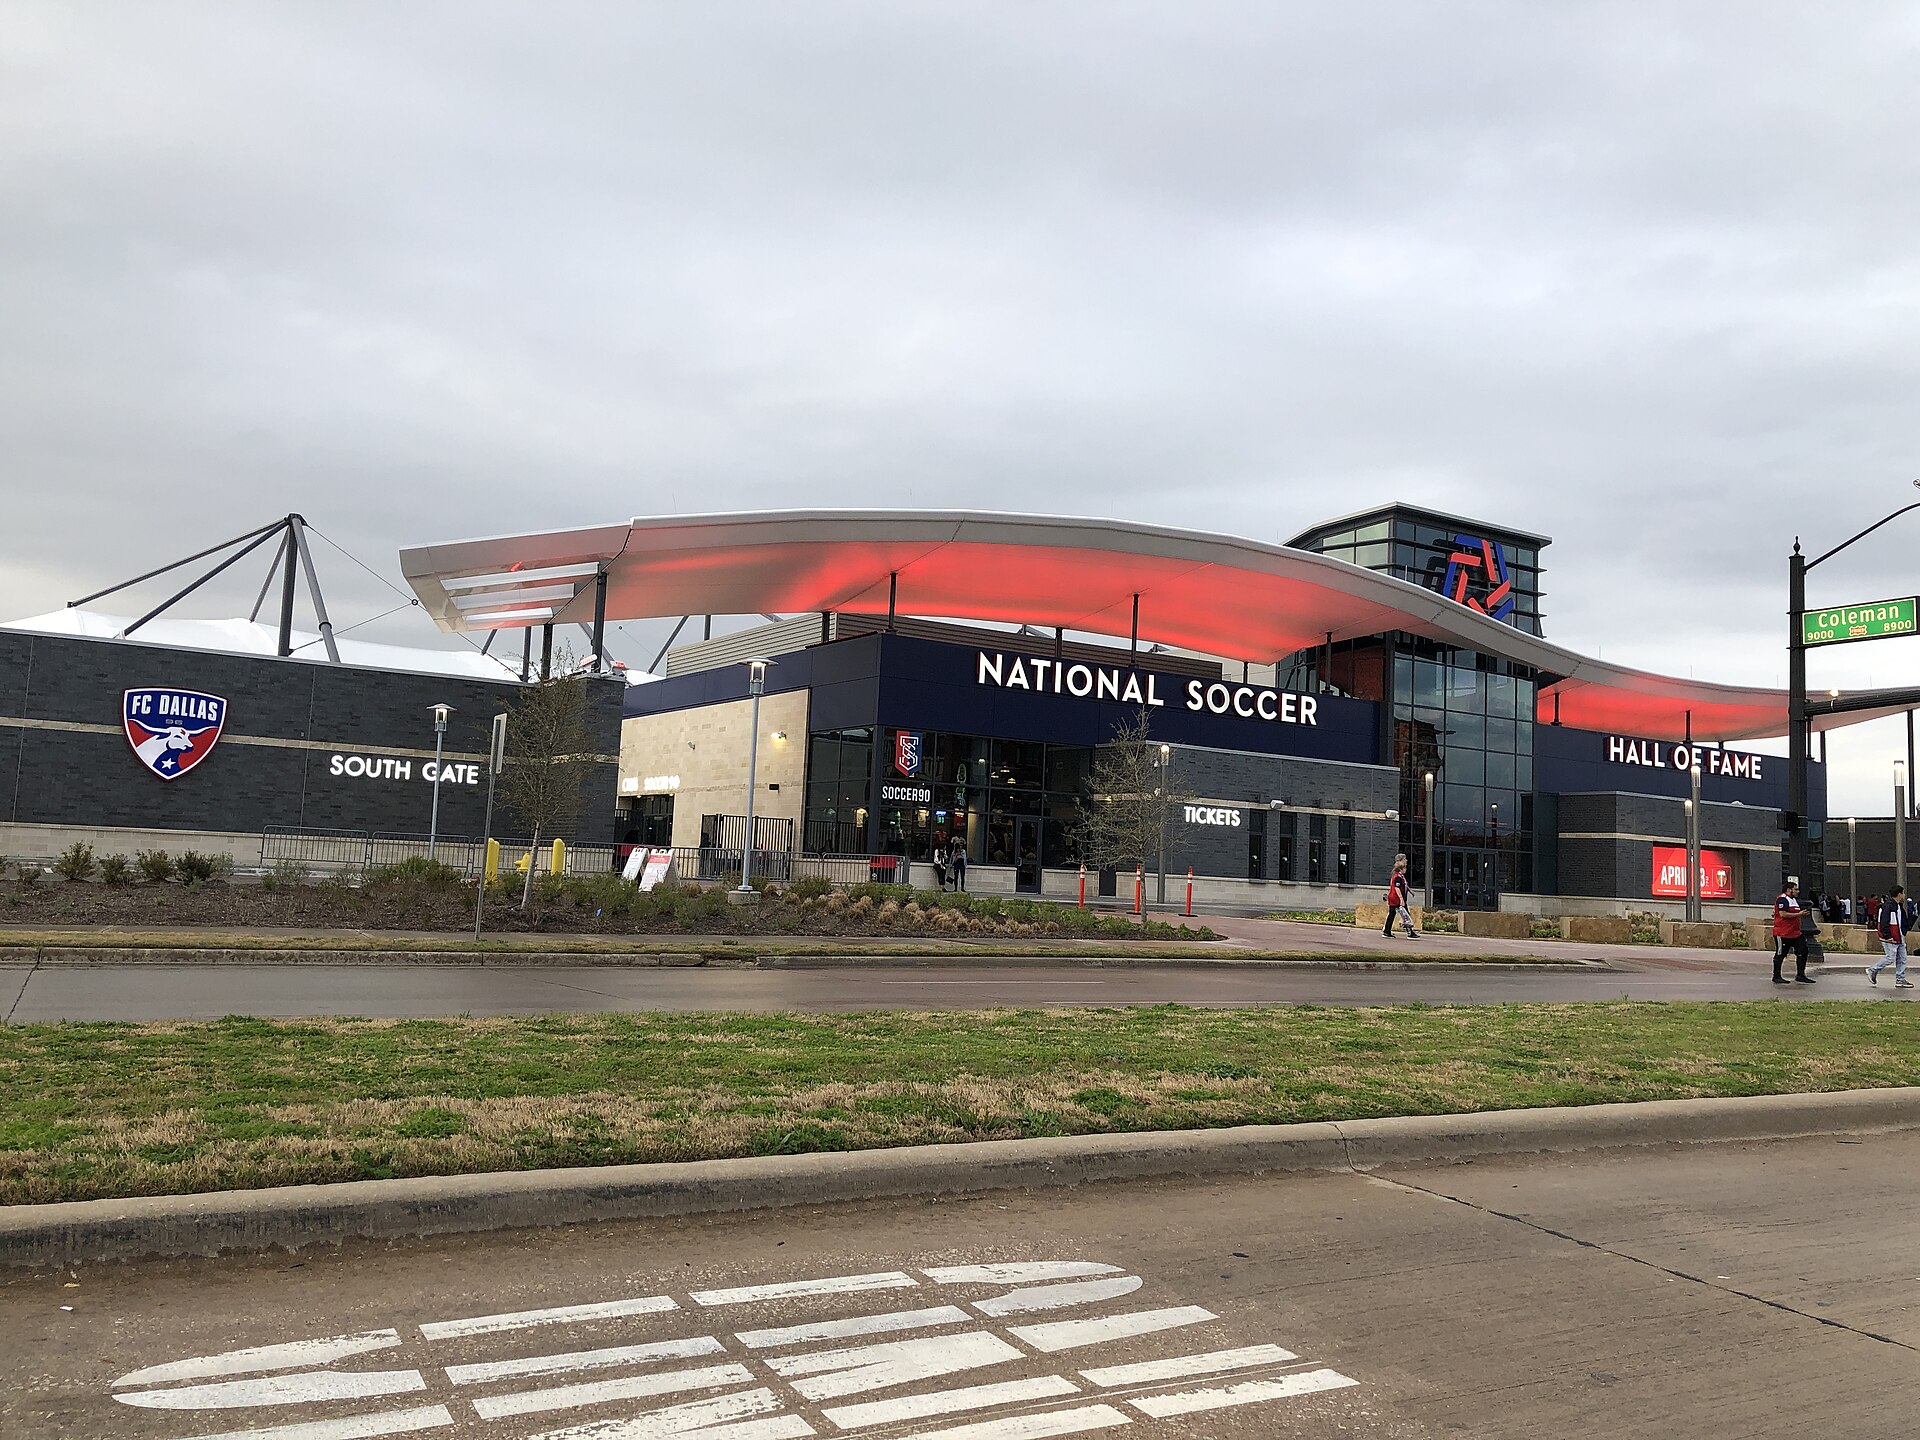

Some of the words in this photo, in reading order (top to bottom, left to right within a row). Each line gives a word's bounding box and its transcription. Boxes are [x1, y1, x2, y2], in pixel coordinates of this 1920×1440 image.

[1818, 605, 1899, 628] Coleman
[1883, 620, 1912, 632] 8900
[1807, 630, 1834, 641] 9000
[978, 651, 1165, 707] NATIONAL
[1186, 680, 1319, 726] SOCCER
[131, 694, 152, 715] FC
[159, 695, 218, 722] DALLAS
[1608, 736, 1666, 768] HALL
[1673, 745, 1702, 771] OF
[1710, 750, 1762, 780] FAME
[329, 755, 411, 780] SOUTH
[421, 761, 479, 786] GATE
[881, 786, 931, 803] SOCCER90
[1183, 805, 1241, 827] TICKETS
